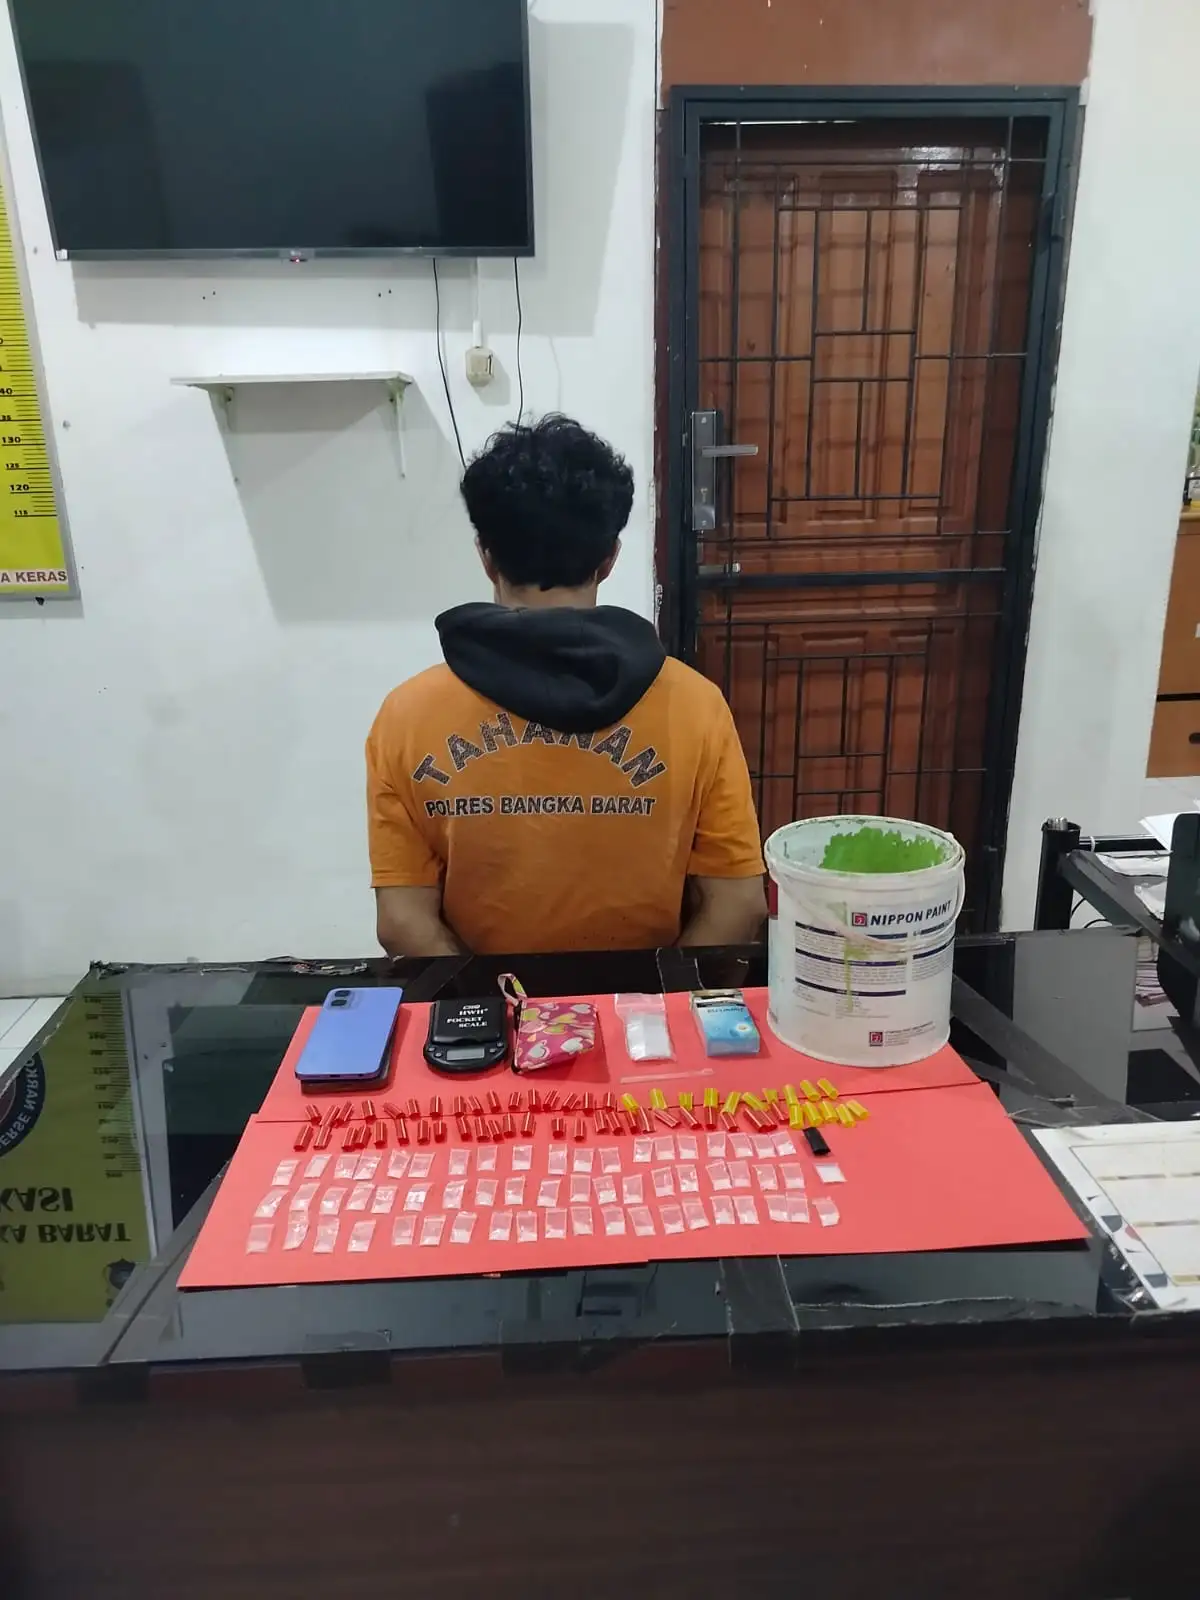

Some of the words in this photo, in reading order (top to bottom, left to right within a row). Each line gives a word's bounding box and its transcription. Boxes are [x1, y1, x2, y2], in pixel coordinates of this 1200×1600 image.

[2, 436, 21, 444] 130
[10, 484, 30, 492] 120
[15, 570, 67, 582] KERAS
[424, 796, 494, 819] POLRES
[500, 795, 585, 815] BANGKA
[590, 795, 656, 816] BARAT
[870, 910, 923, 926] NIPPON
[926, 900, 951, 919] PAINT
